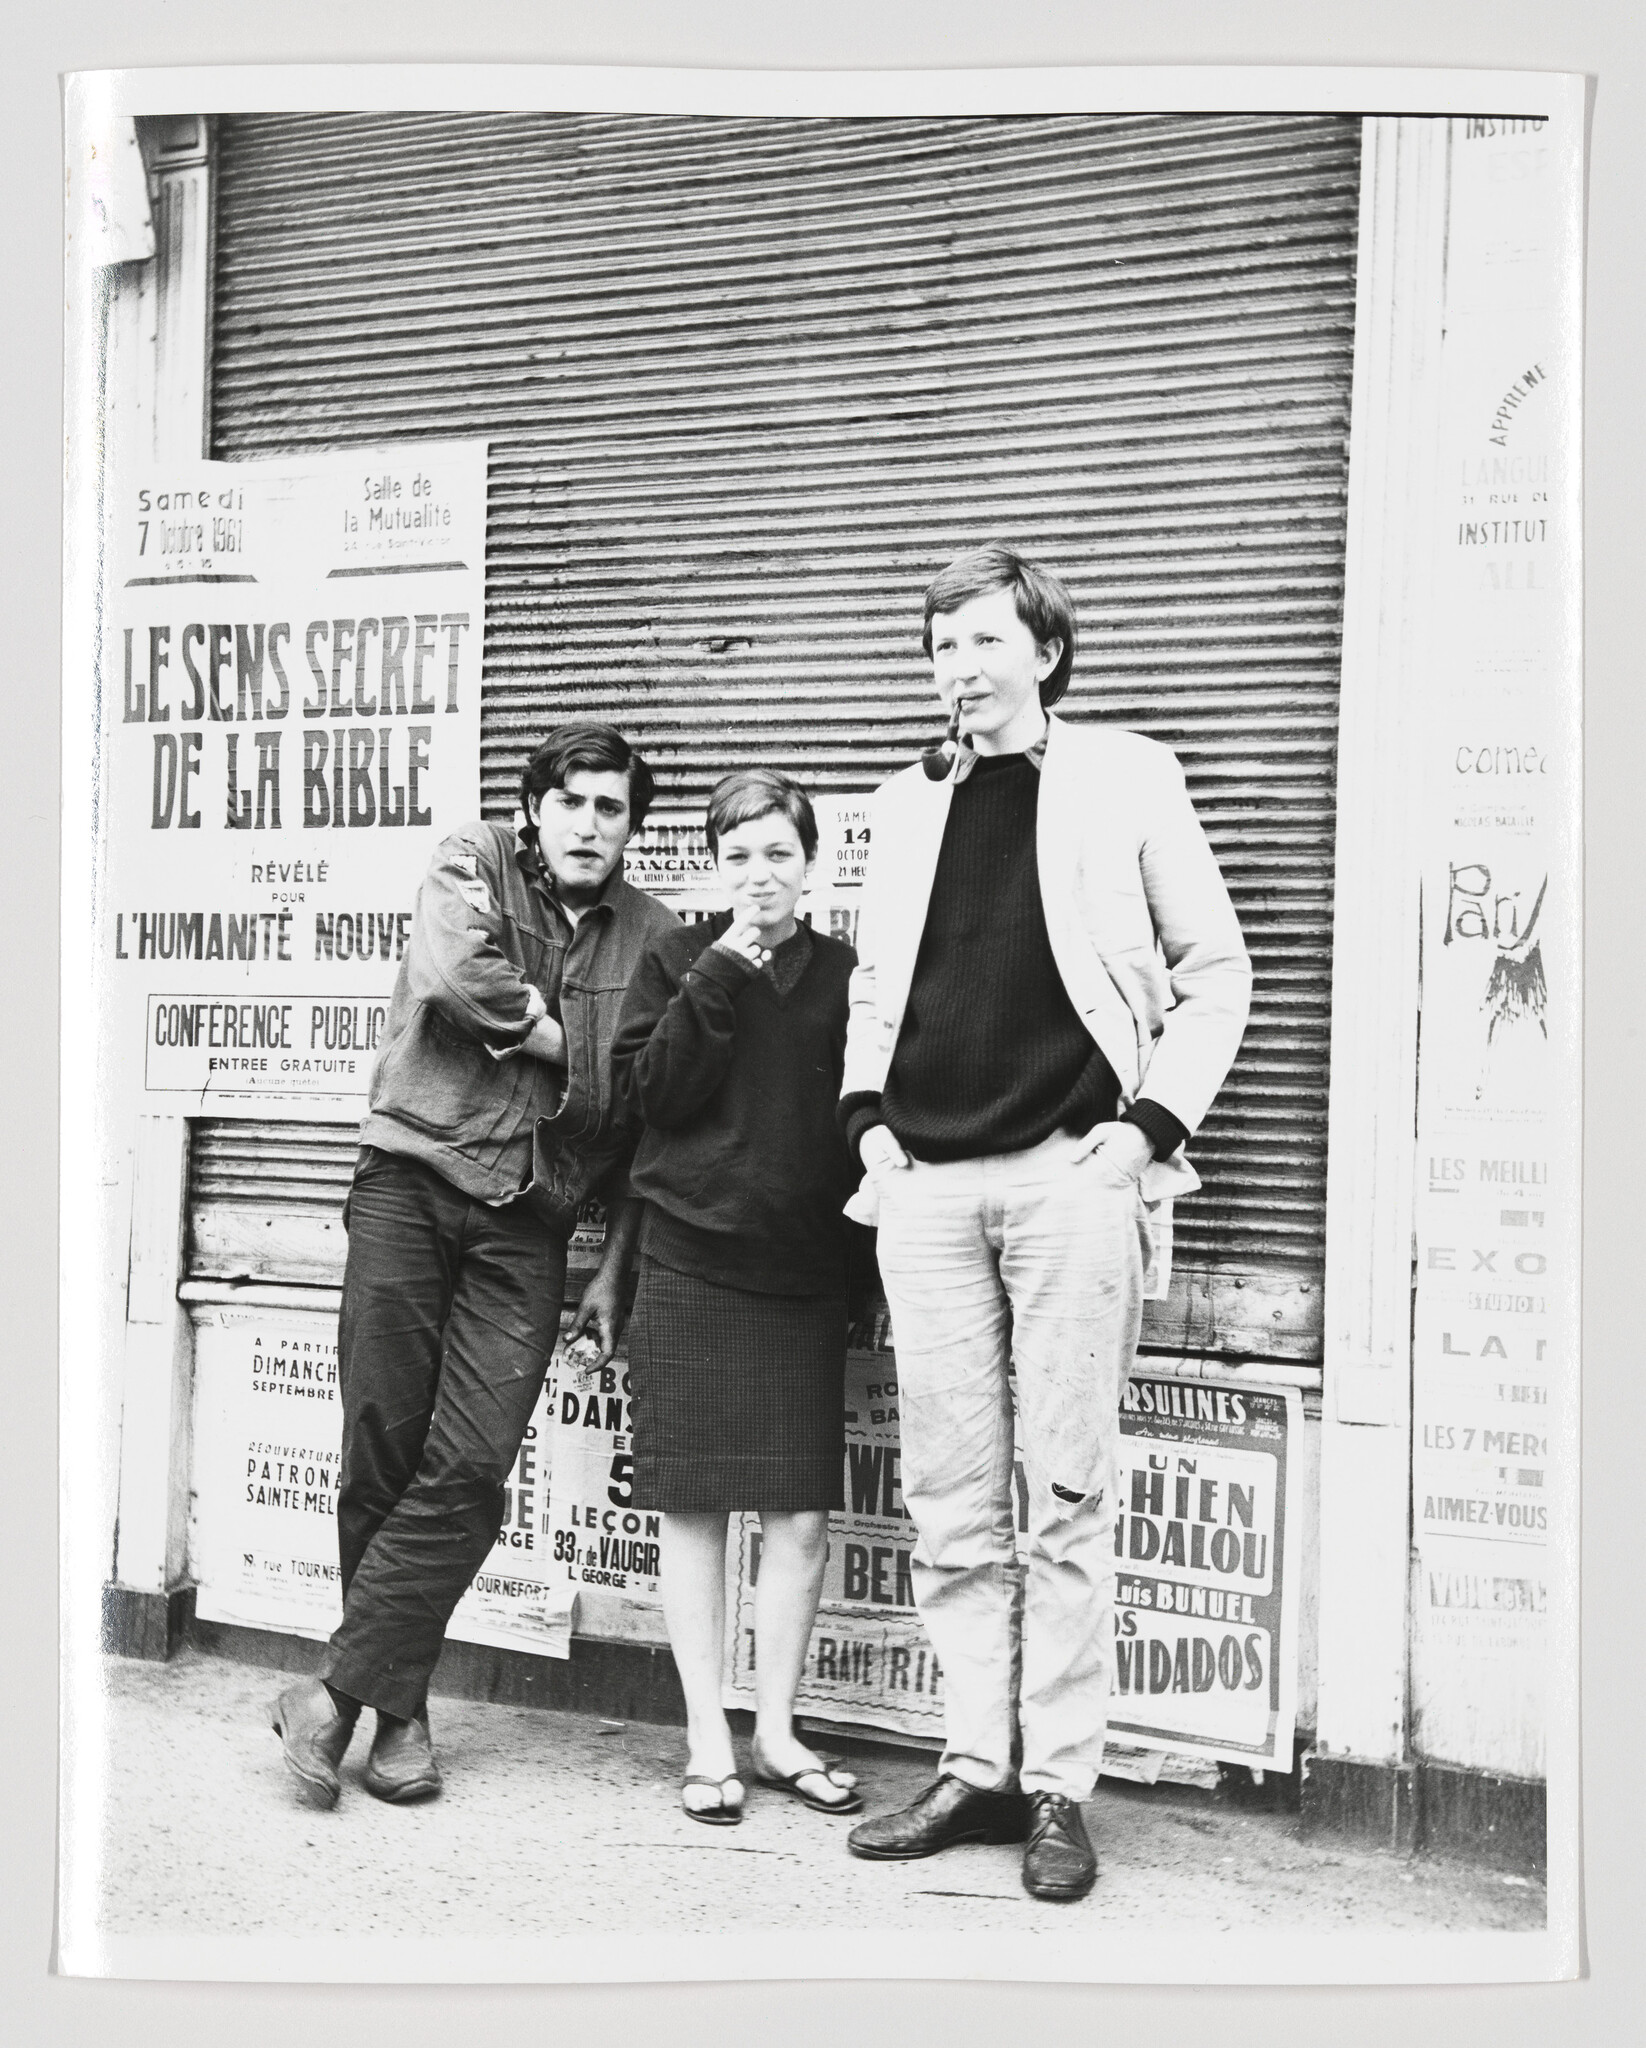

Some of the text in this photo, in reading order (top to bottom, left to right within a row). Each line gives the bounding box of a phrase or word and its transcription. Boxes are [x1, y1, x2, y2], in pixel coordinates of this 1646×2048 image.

[138, 487, 244, 512] Samedi
[364, 473, 431, 502] Salle de
[344, 502, 452, 534] la Mutualité
[138, 520, 150, 556] 7
[213, 516, 243, 553] 1961
[1458, 519, 1548, 546] INSTITUT
[122, 612, 470, 724] LE SENS SECRET
[151, 726, 432, 830] DE LA BIBLE
[837, 811, 872, 823] SAME
[844, 828, 872, 844] 14
[251, 860, 330, 883] RÉVÉLÉ
[272, 893, 306, 903] POUR
[116, 907, 294, 961] L'HUMANITÉ
[155, 1001, 391, 1051] CONFÉRENCE PUBLIQ
[280, 1058, 356, 1074] GRATUITE
[1428, 1157, 1466, 1182] LES
[254, 1337, 263, 1347] A
[252, 1380, 335, 1401] SEPTEMBRE
[1424, 1424, 1456, 1450] LES
[1462, 1428, 1477, 1451] 7
[1147, 1453, 1198, 1475] UN
[844, 1443, 910, 1520] WE
[1118, 1468, 1255, 1528] HIEN
[553, 1530, 576, 1563] 33
[600, 1536, 661, 1577] VAUGIR
[471, 1576, 550, 1601] OURNEFORT
[582, 1568, 627, 1589] GEORGE
[1110, 1632, 1264, 1697] VIDADOS
